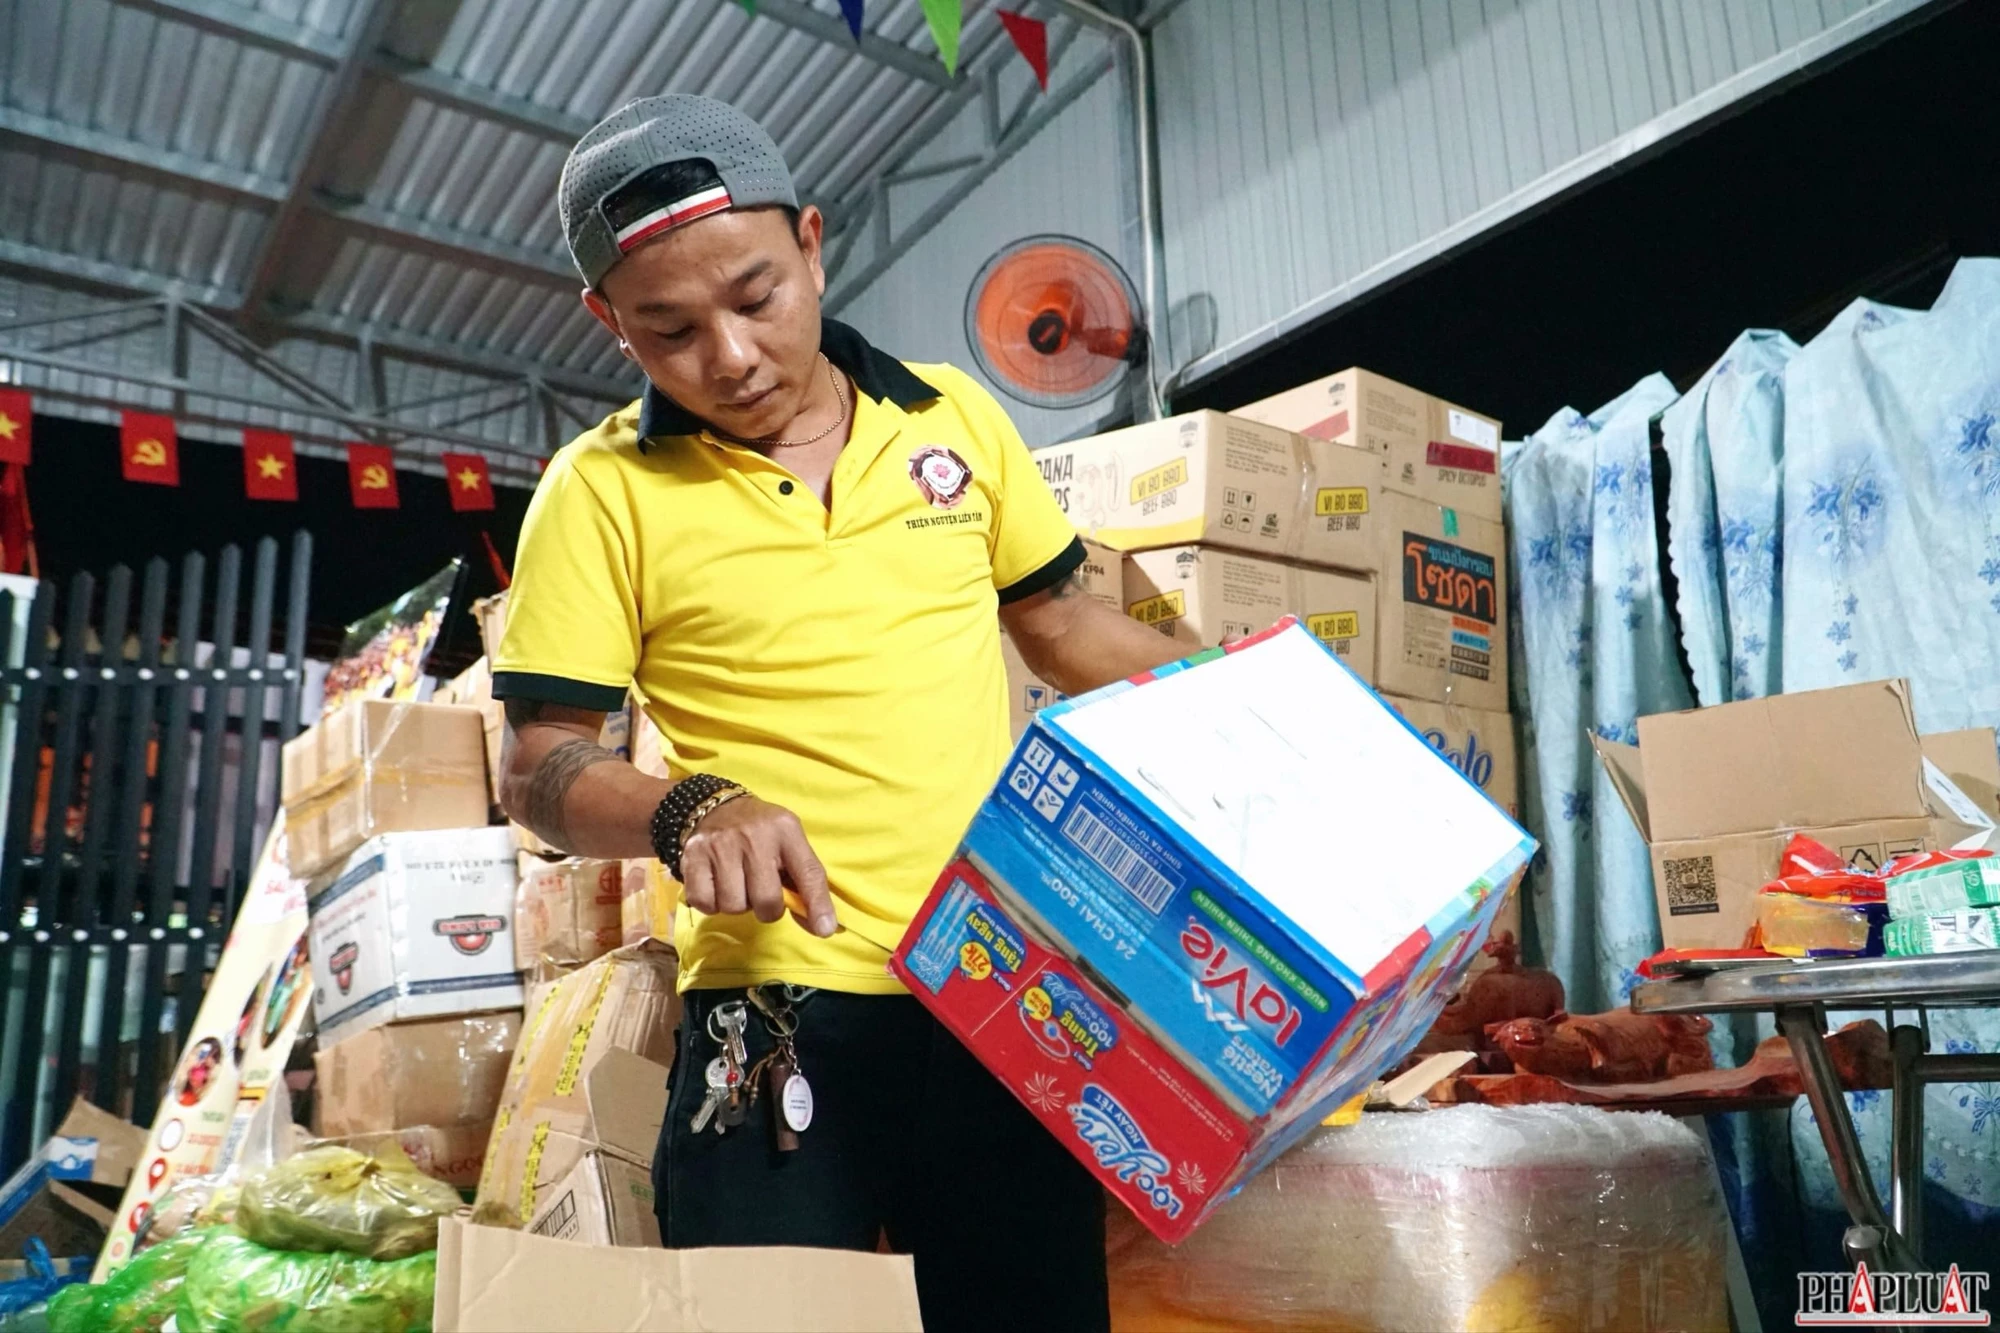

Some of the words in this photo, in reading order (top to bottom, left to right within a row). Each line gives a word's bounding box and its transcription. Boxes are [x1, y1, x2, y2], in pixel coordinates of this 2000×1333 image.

[1406, 541, 1495, 619] โซดา
[1149, 838, 1164, 853] RA
[1162, 848, 1183, 869] SINH
[964, 909, 996, 944] ngay
[1077, 903, 1117, 943] CHAI
[992, 935, 1021, 973] Tặng
[1114, 936, 1137, 962] 24
[1038, 1001, 1051, 1018] 5
[1058, 1007, 1099, 1058] Trúng
[1086, 1019, 1115, 1049] 100
[1219, 1042, 1279, 1100] Nestlé
[1228, 1032, 1287, 1088] Waters
[1135, 1170, 1182, 1220] LỘC
